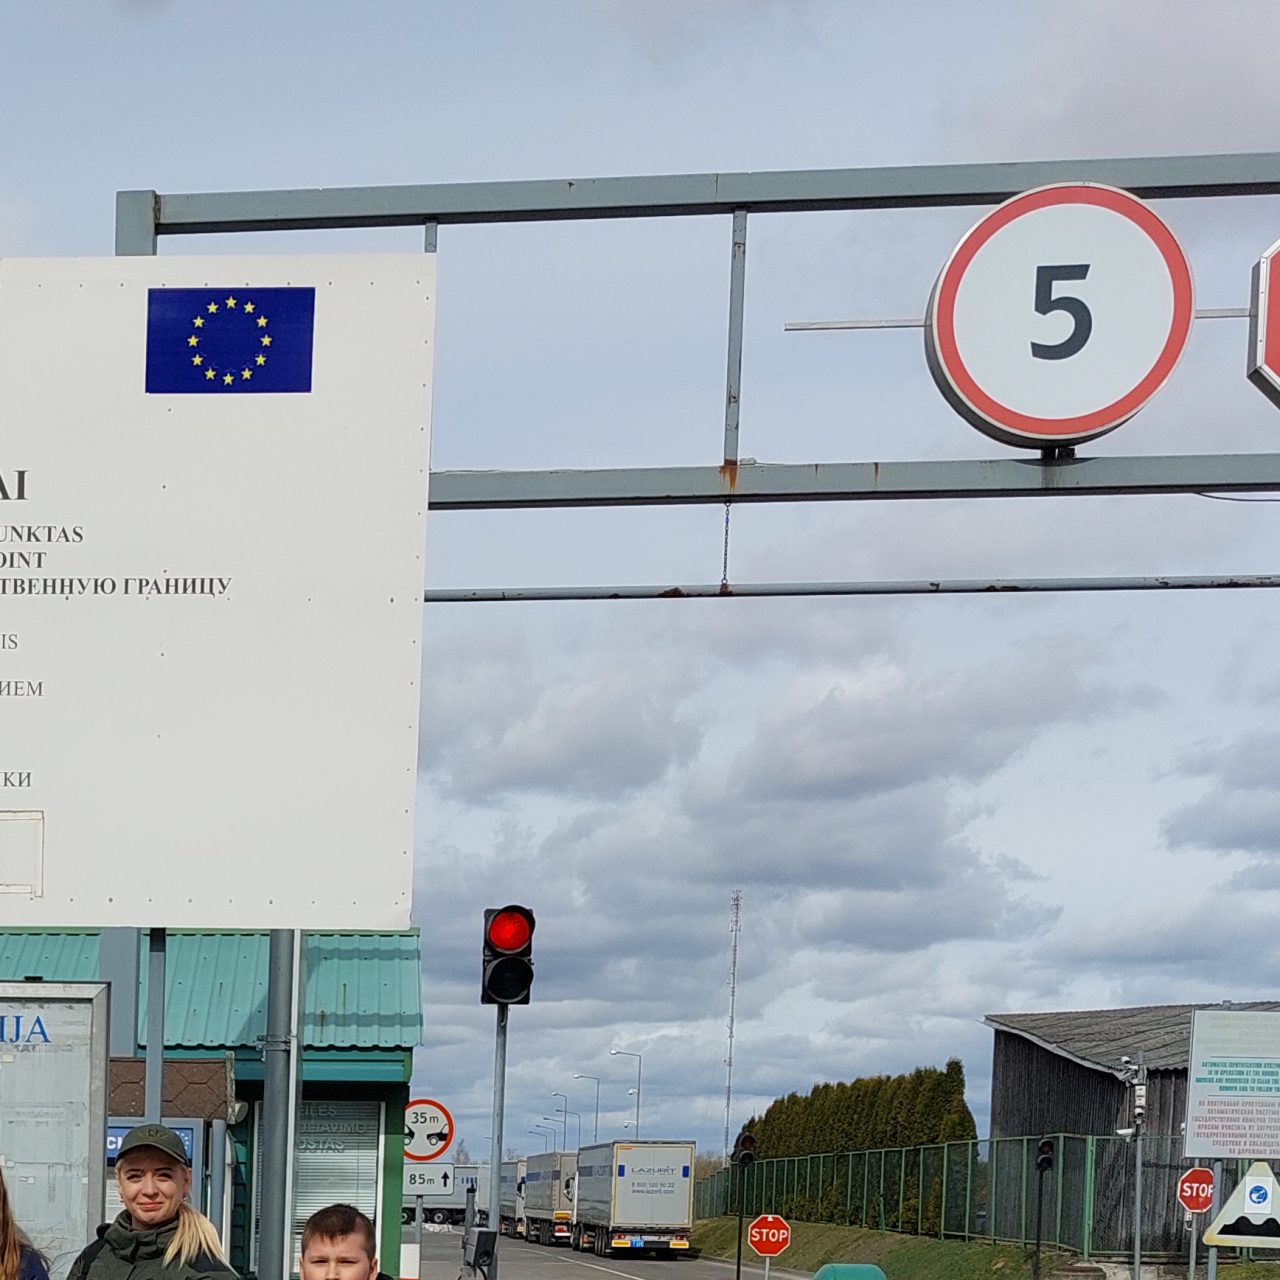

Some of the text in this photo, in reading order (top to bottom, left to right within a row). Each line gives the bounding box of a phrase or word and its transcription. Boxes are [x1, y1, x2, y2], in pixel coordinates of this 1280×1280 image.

[1030, 263, 1093, 361] 5
[123, 578, 232, 597] ГРАНИЦУ
[751, 1228, 788, 1242] STOP
